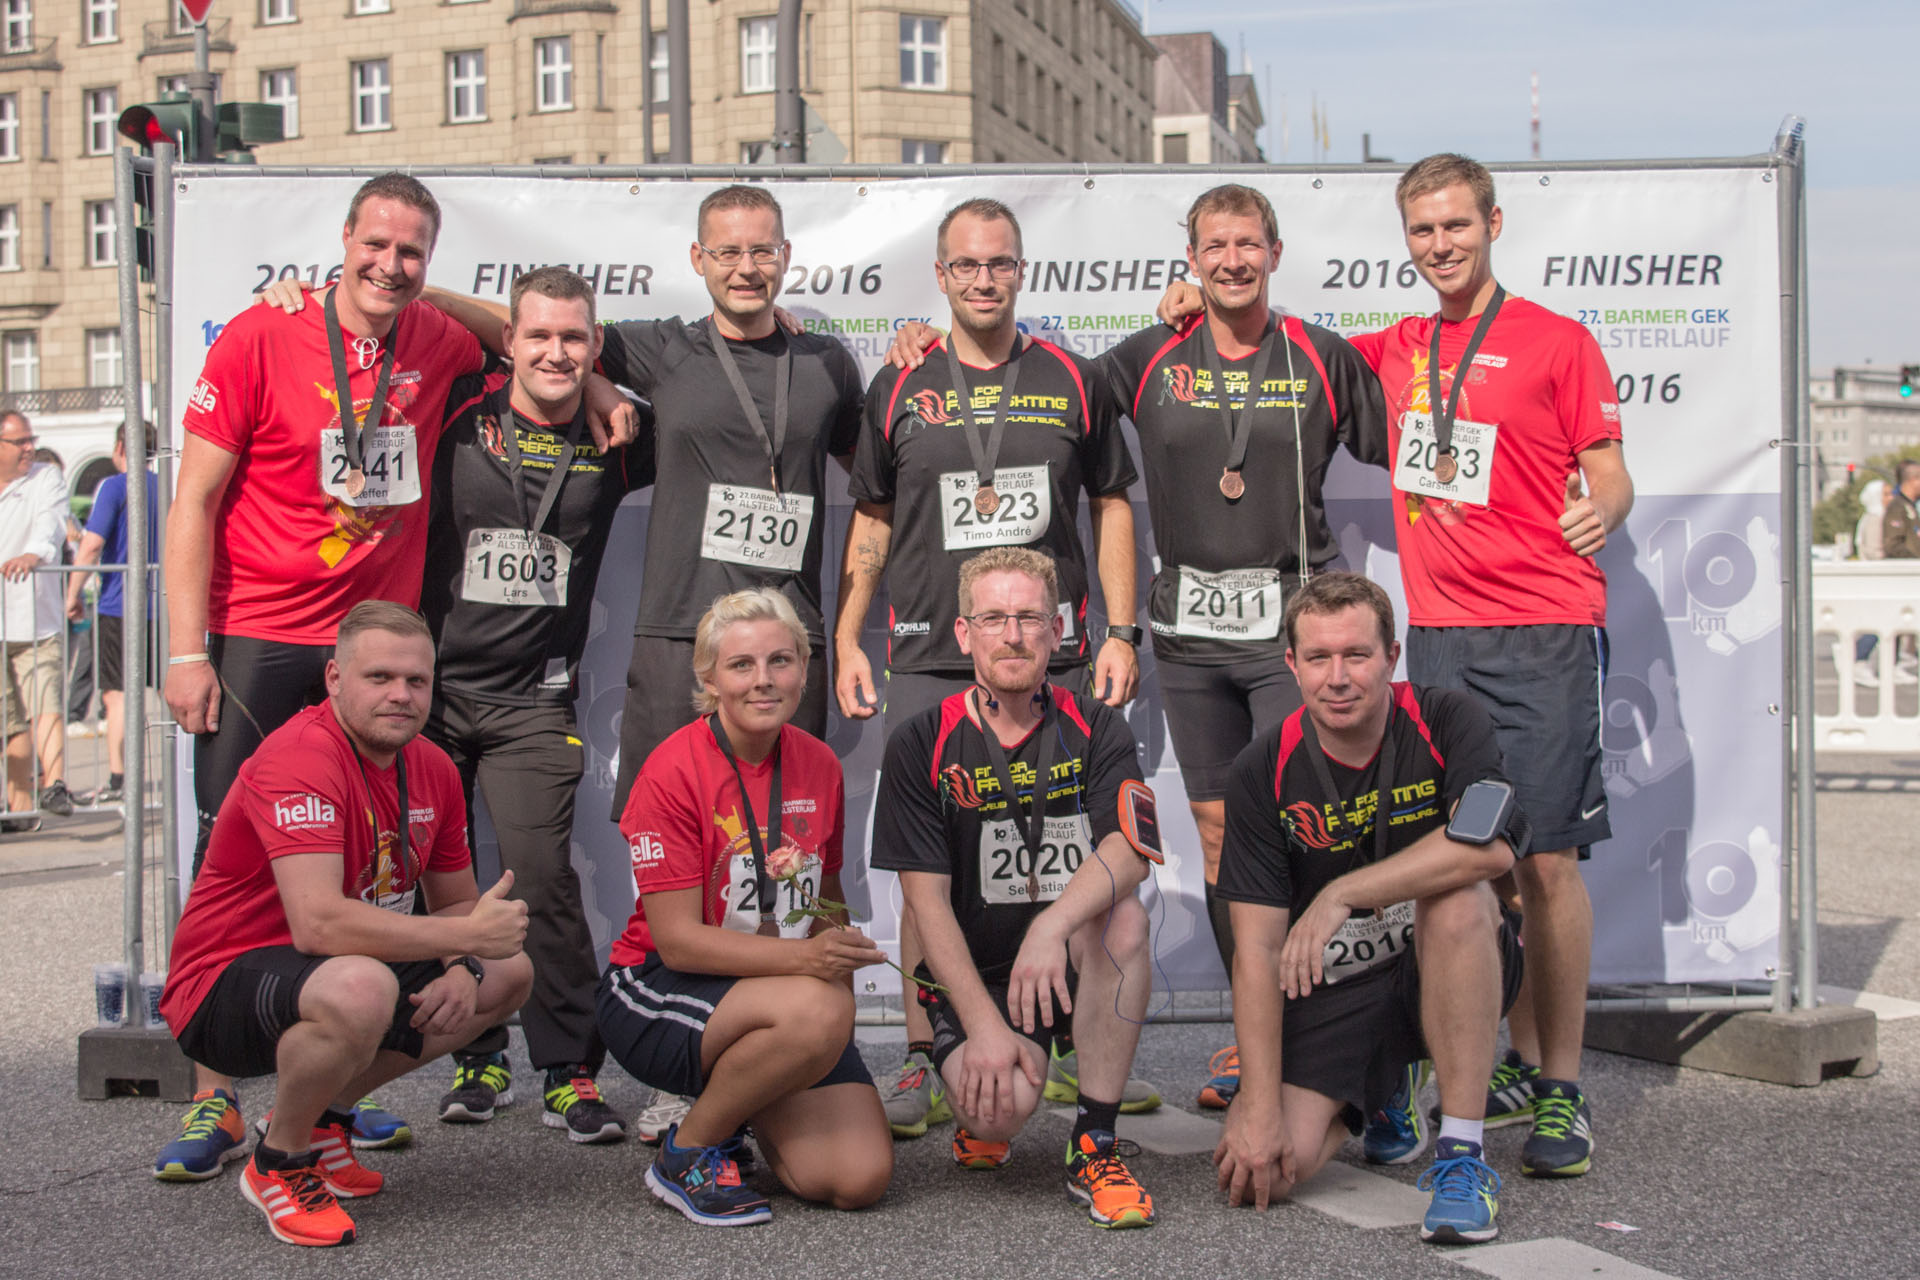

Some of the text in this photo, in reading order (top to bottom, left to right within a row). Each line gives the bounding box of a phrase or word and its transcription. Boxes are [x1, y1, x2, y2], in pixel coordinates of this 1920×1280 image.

[1022, 259, 1191, 293] INISHER
[1322, 258, 1418, 289] 2016
[1543, 254, 1723, 287] FINISHER
[784, 263, 882, 295] 2016
[1041, 315, 1064, 331] 27.
[1313, 312, 1337, 328] 27.
[1578, 309, 1729, 324] 27. BARMER GEK
[803, 317, 889, 334] BARMER
[1597, 327, 1731, 348] LSTERLAUF
[1616, 373, 1681, 404] 016
[528, 433, 555, 443] FOR
[1466, 427, 1481, 435] GEK
[953, 478, 966, 490] 10
[1419, 477, 1459, 493] Carsten
[723, 491, 735, 501] 10
[740, 500, 800, 515] ALSTERLAUF
[714, 509, 798, 547] 2130
[963, 526, 1032, 541] Timo André
[481, 533, 493, 542] 10
[743, 546, 765, 560] Eric
[478, 552, 557, 583] 1603
[504, 587, 528, 598] Lars
[1187, 588, 1266, 619] 2011
[1209, 622, 1249, 633] Torben
[1692, 612, 1728, 633] km
[275, 796, 335, 827] hella
[1058, 821, 1076, 829] GEK
[994, 829, 1006, 840] 10
[630, 836, 665, 862] ella
[992, 843, 1083, 880] 2020
[1692, 922, 1728, 943] km
